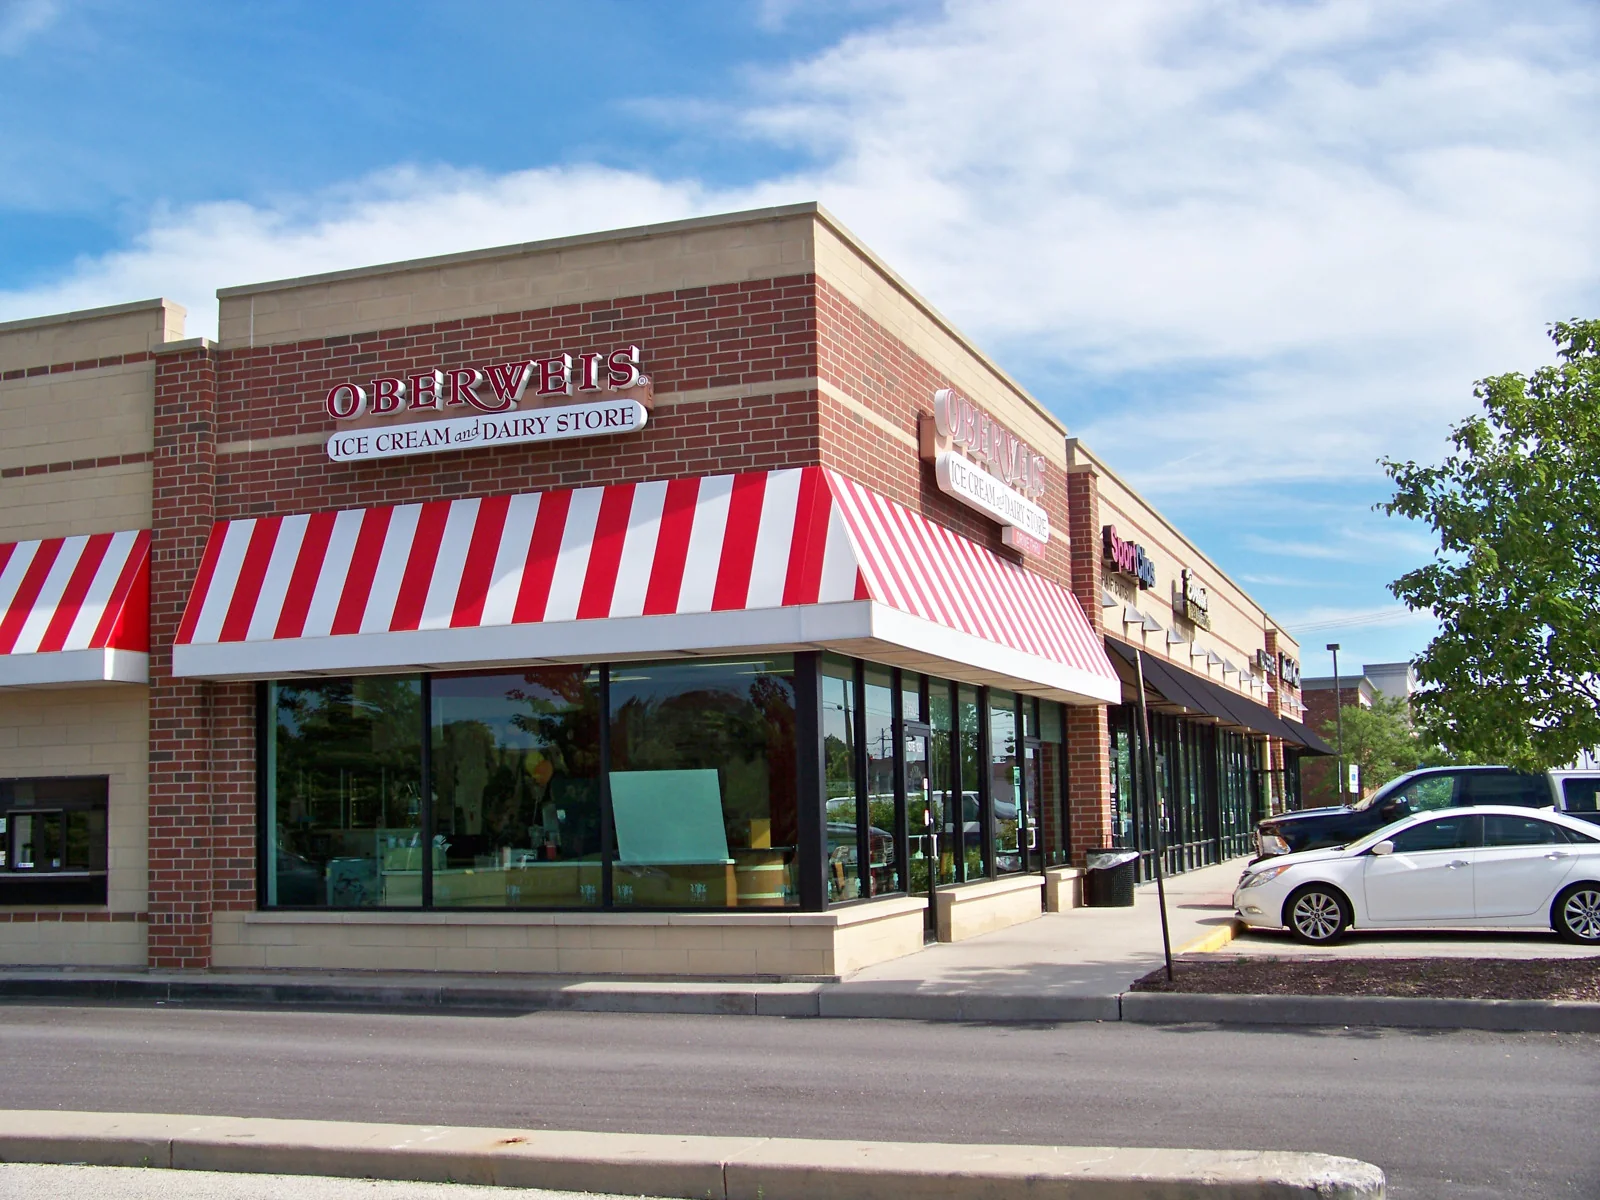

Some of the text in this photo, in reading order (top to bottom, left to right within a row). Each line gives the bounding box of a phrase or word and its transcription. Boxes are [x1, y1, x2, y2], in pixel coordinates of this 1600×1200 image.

[326, 344, 639, 420] OBERWEIS
[333, 406, 635, 457] ICE CREAM and DAIRY STORE
[951, 460, 967, 489] ICE
[968, 471, 996, 507] CREAM
[1004, 494, 1025, 525] DAIRY
[1026, 508, 1047, 538] STORE
